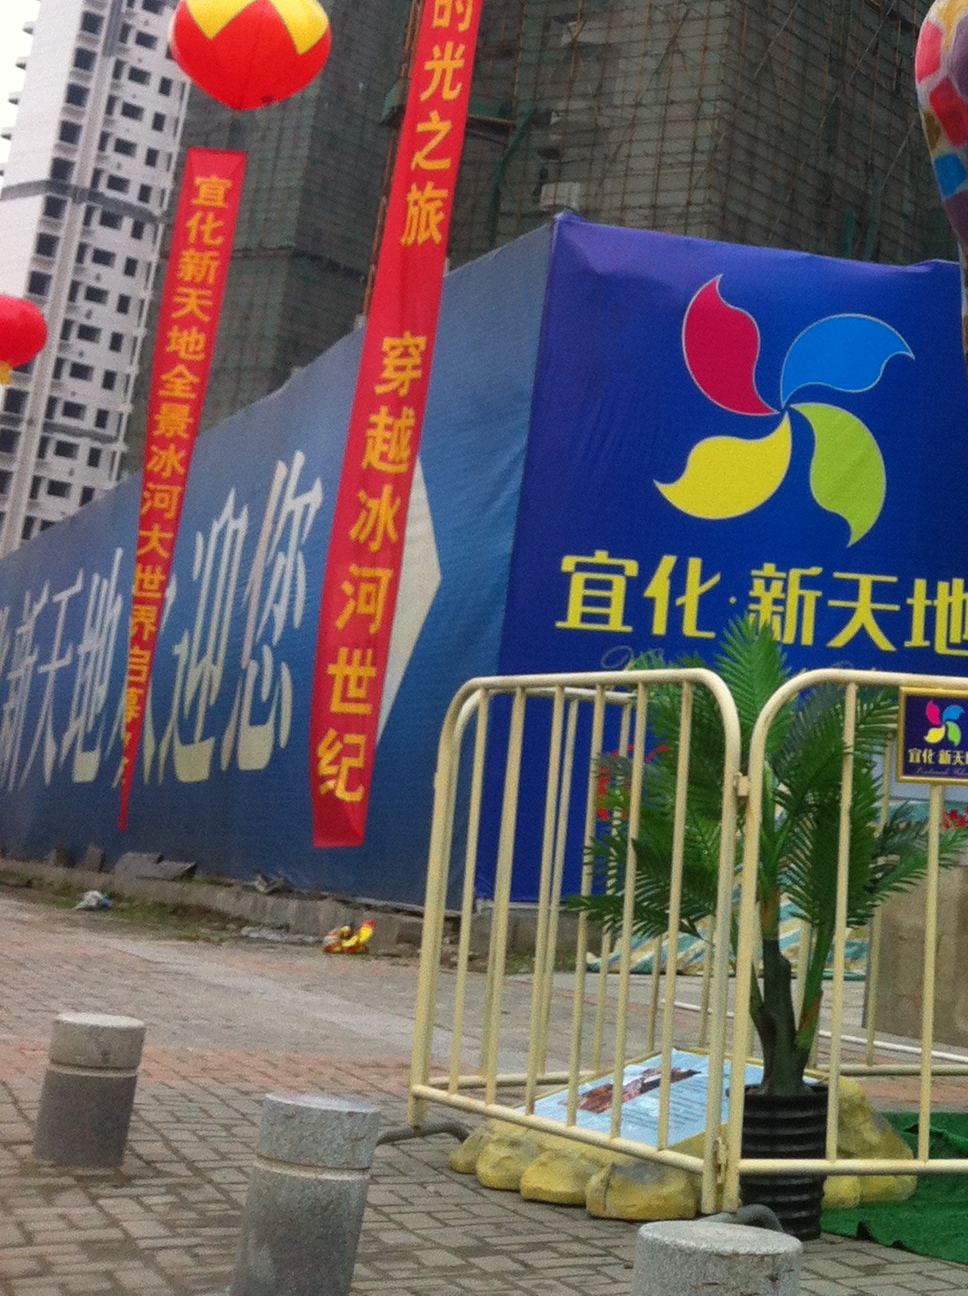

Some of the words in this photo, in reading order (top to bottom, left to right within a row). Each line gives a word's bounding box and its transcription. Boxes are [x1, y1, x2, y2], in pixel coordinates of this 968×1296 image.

[316, 330, 428, 803] 穿越冰河世纪
